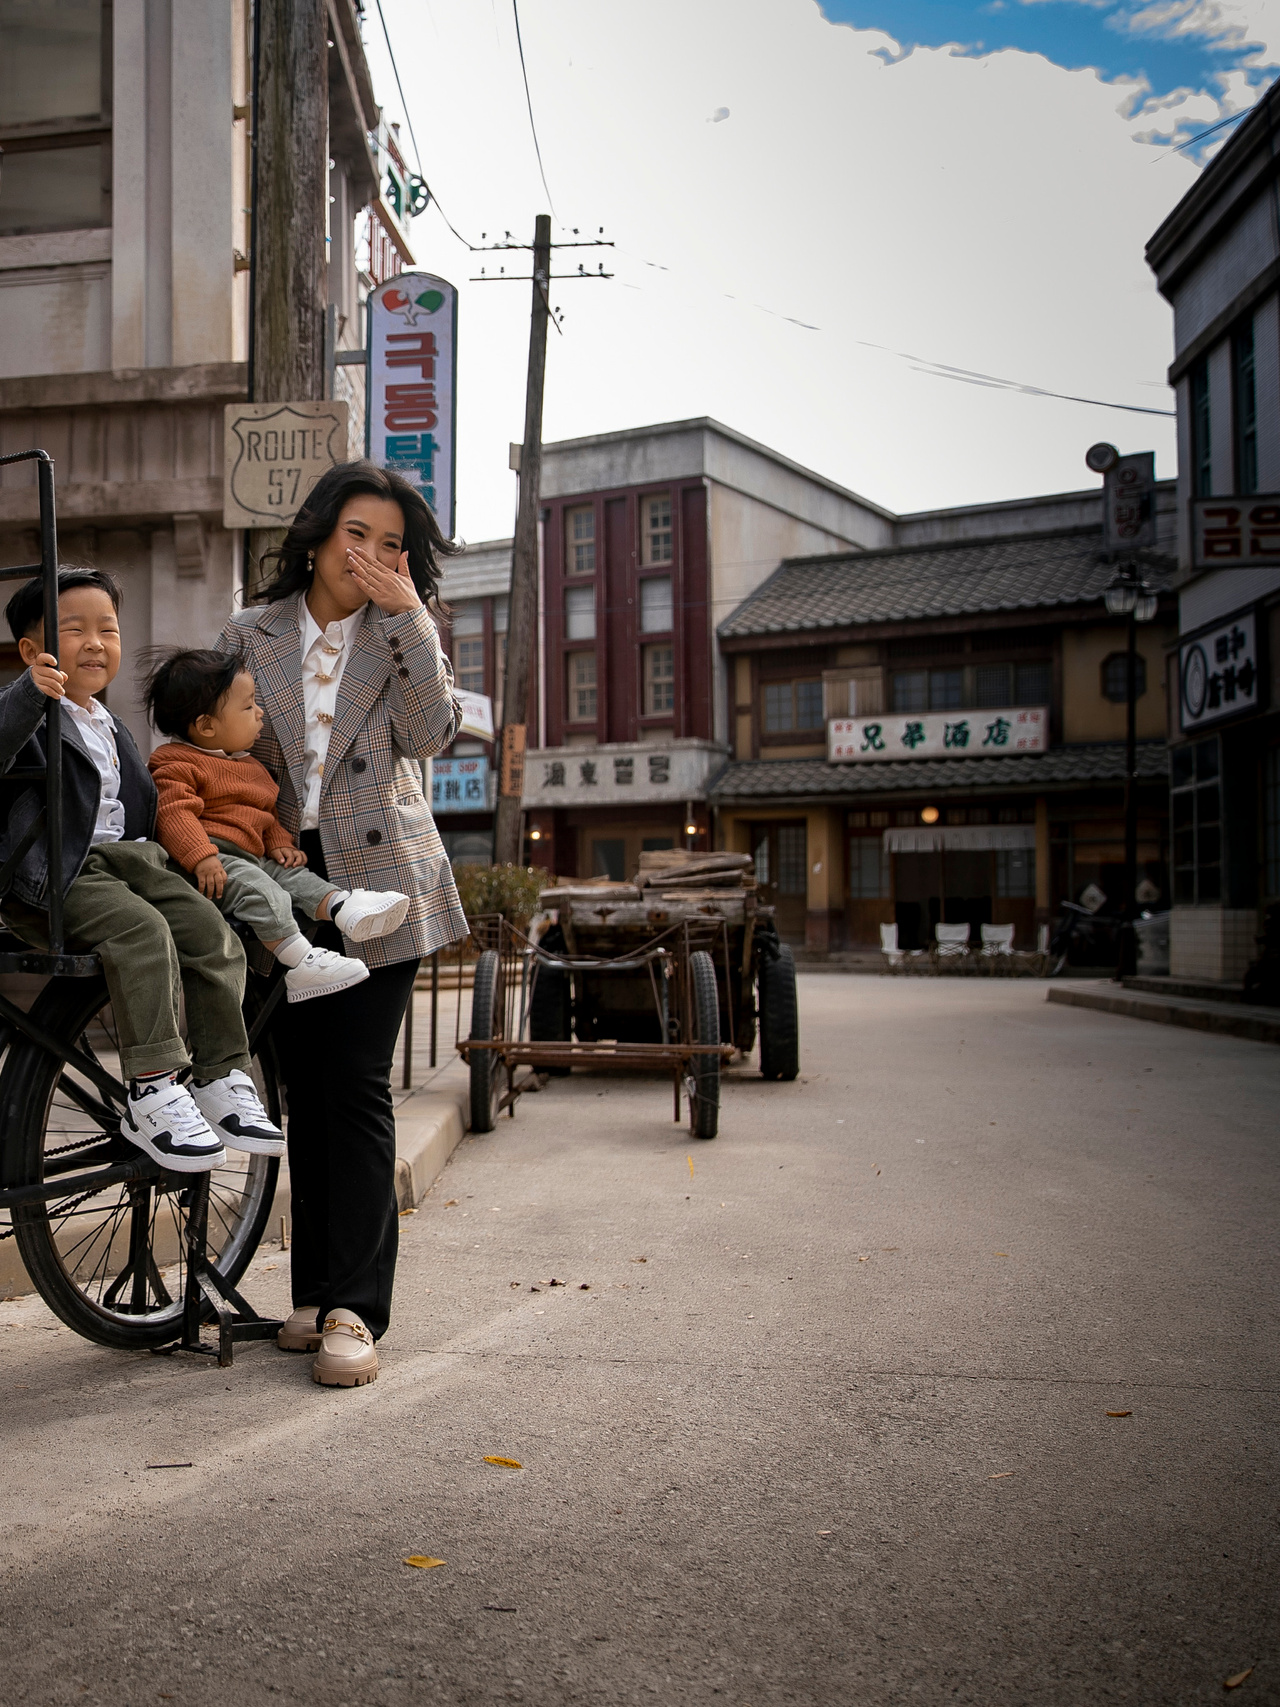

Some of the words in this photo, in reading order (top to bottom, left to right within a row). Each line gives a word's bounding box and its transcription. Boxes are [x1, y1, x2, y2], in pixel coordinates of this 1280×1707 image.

[247, 429, 323, 462] ROUTE
[268, 468, 301, 505] 57
[146, 1114, 157, 1127] FILA
